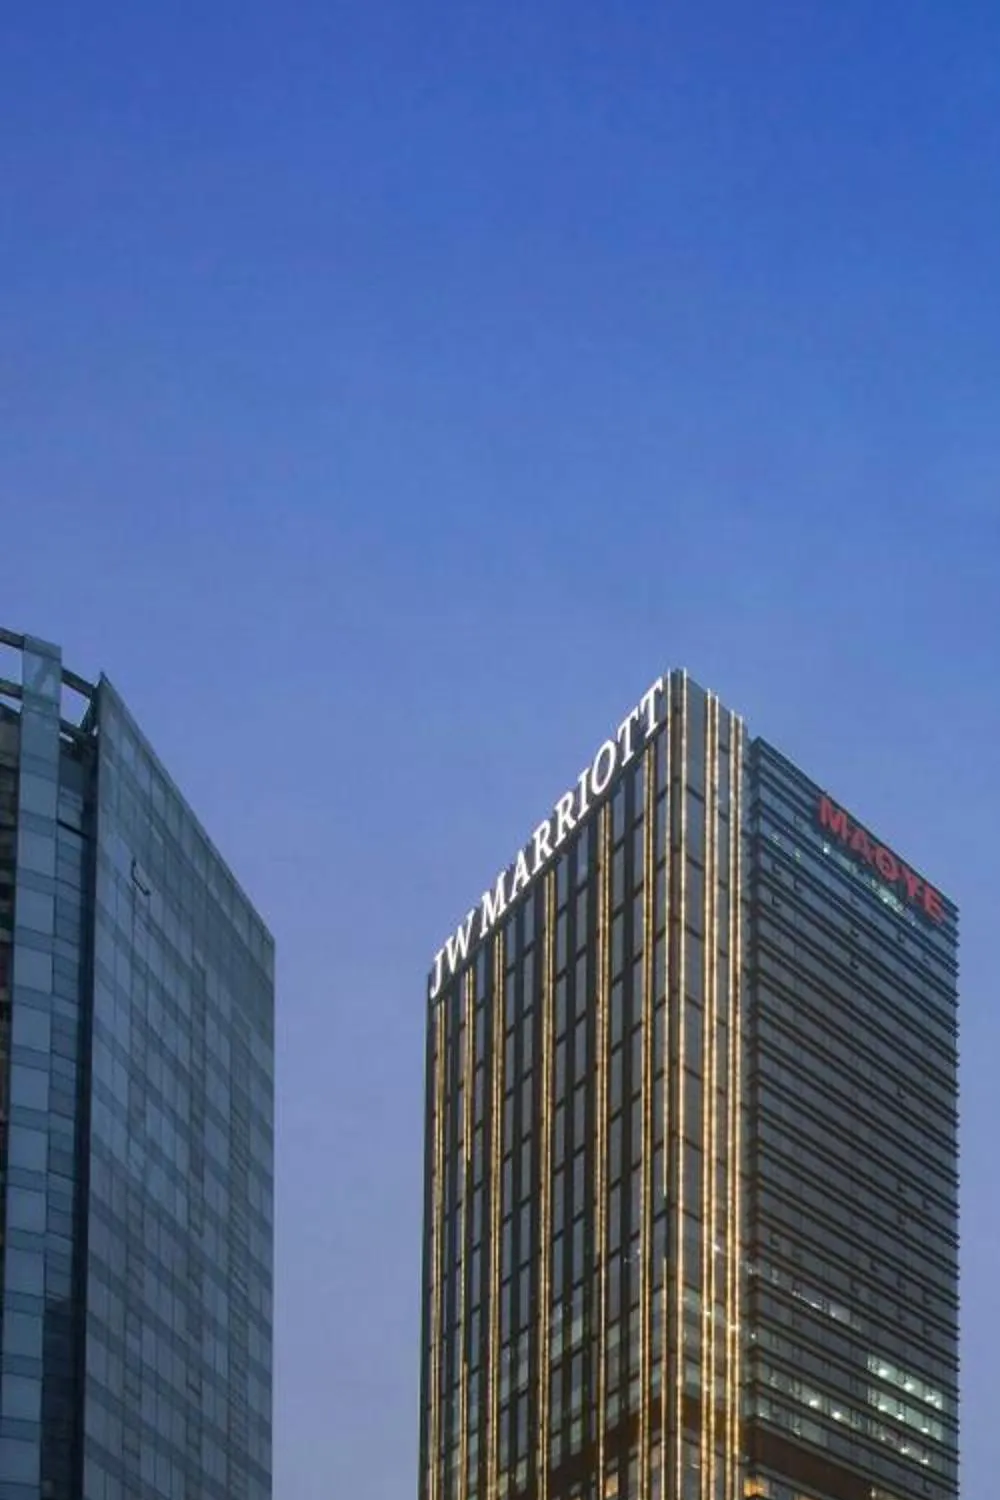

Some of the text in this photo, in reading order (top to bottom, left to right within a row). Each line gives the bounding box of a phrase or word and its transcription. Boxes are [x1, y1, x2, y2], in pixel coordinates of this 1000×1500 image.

[430, 676, 663, 999] JW MARRIOTT
[819, 796, 945, 926] MAOYE
